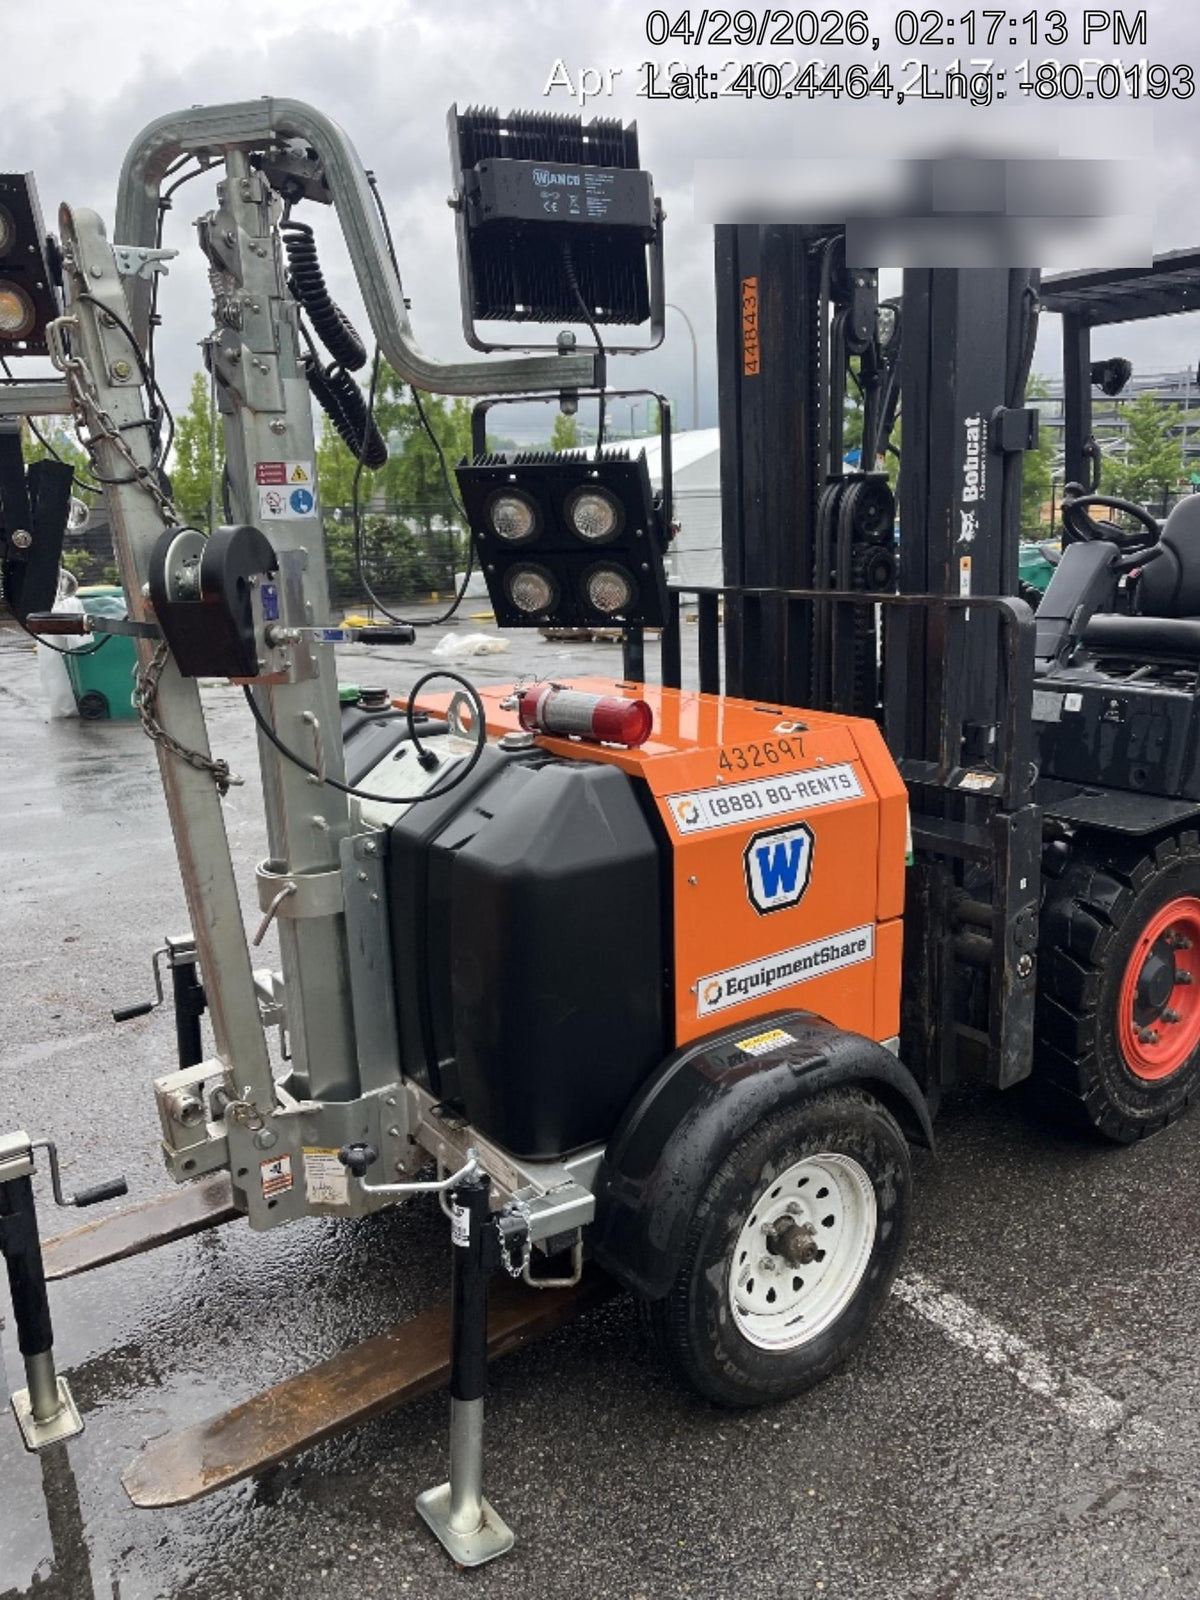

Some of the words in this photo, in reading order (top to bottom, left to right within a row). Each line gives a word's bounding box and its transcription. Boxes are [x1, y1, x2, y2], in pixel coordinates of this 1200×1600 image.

[533, 168, 580, 188] WANCO
[742, 282, 758, 373] 448437
[962, 416, 980, 502] Bobcat
[718, 736, 806, 773] 432697
[755, 837, 805, 899] W
[725, 937, 867, 997] EquipmentShare
